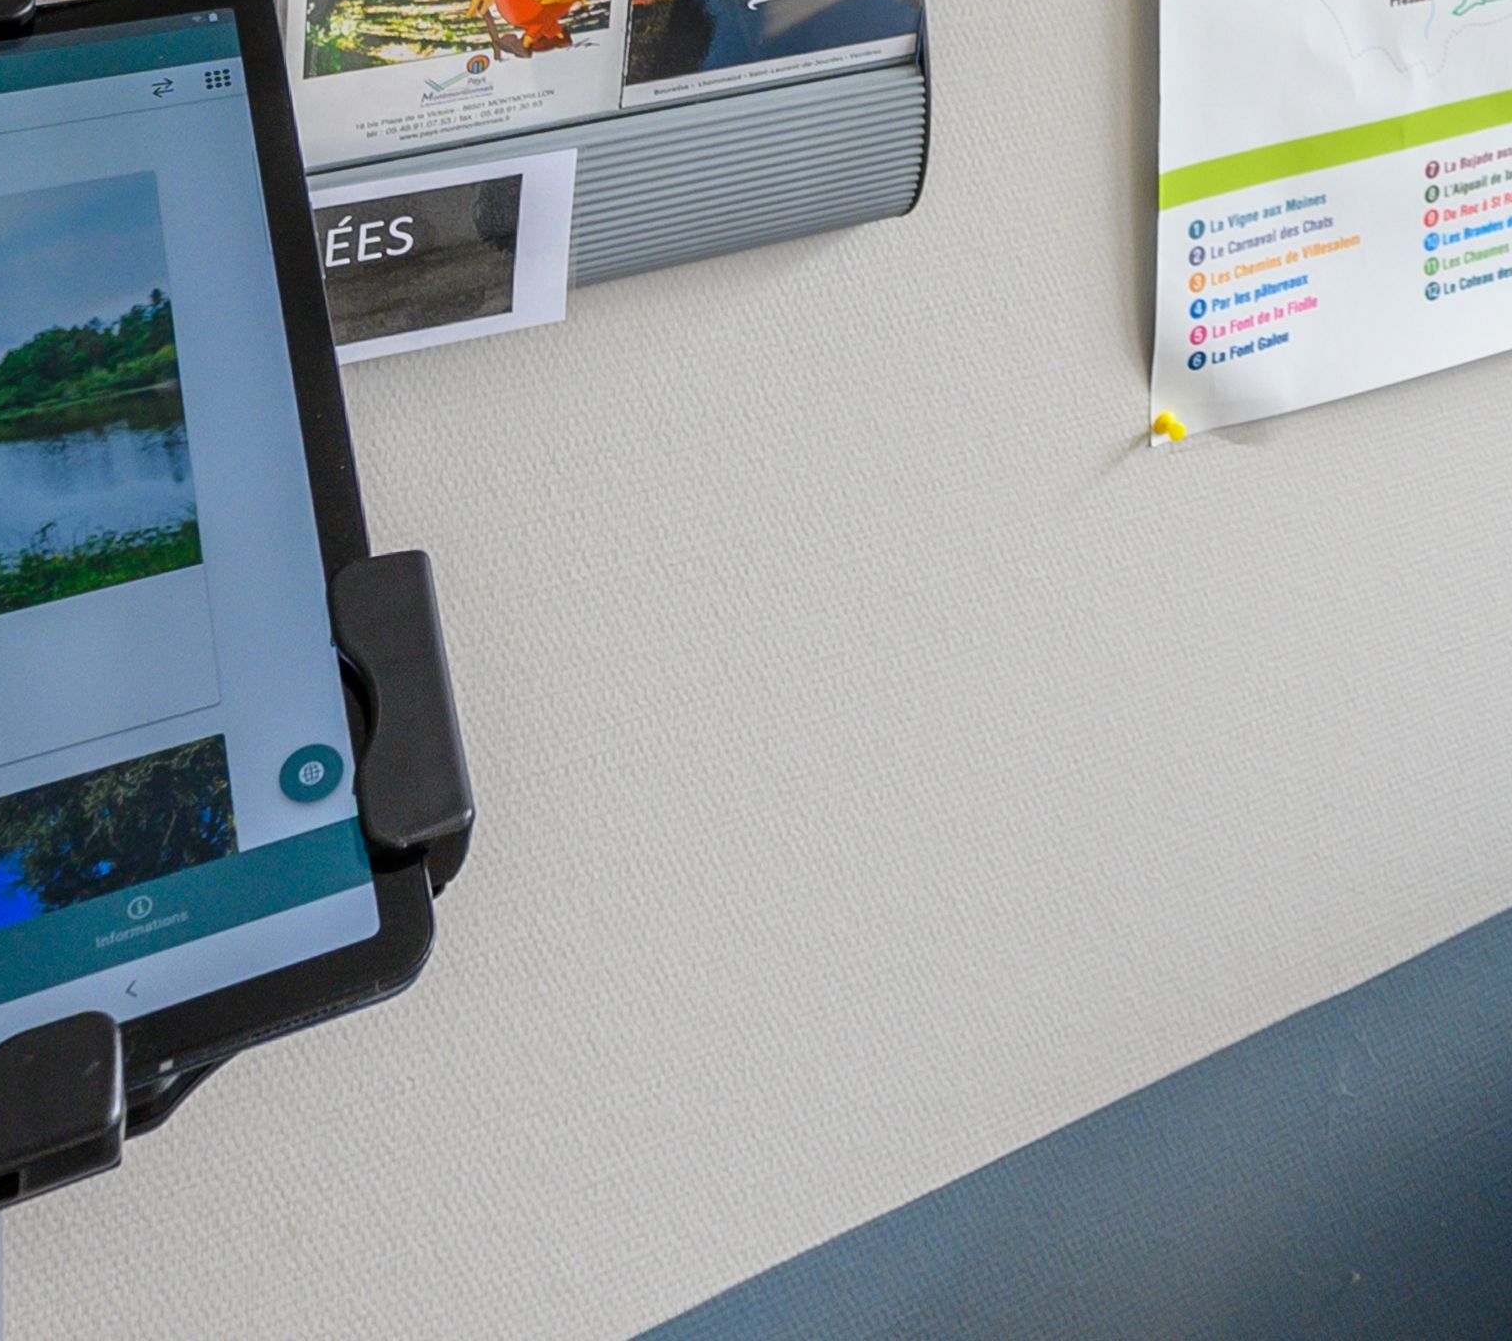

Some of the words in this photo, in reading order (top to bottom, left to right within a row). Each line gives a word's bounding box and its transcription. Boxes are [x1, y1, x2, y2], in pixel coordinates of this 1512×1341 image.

[1210, 219, 1224, 233] La
[1228, 211, 1259, 228] Vigne
[1262, 205, 1282, 218] aux
[1285, 193, 1327, 213] Moines
[1211, 245, 1224, 259] Le
[1228, 230, 1277, 254] Carnaval
[1280, 225, 1300, 240] des
[1303, 216, 1334, 233] Chats
[1212, 324, 1226, 339] La
[1230, 315, 1254, 334] Font
[1257, 311, 1270, 324] de
[1274, 306, 1284, 319] la
[95, 908, 190, 950] Informations
